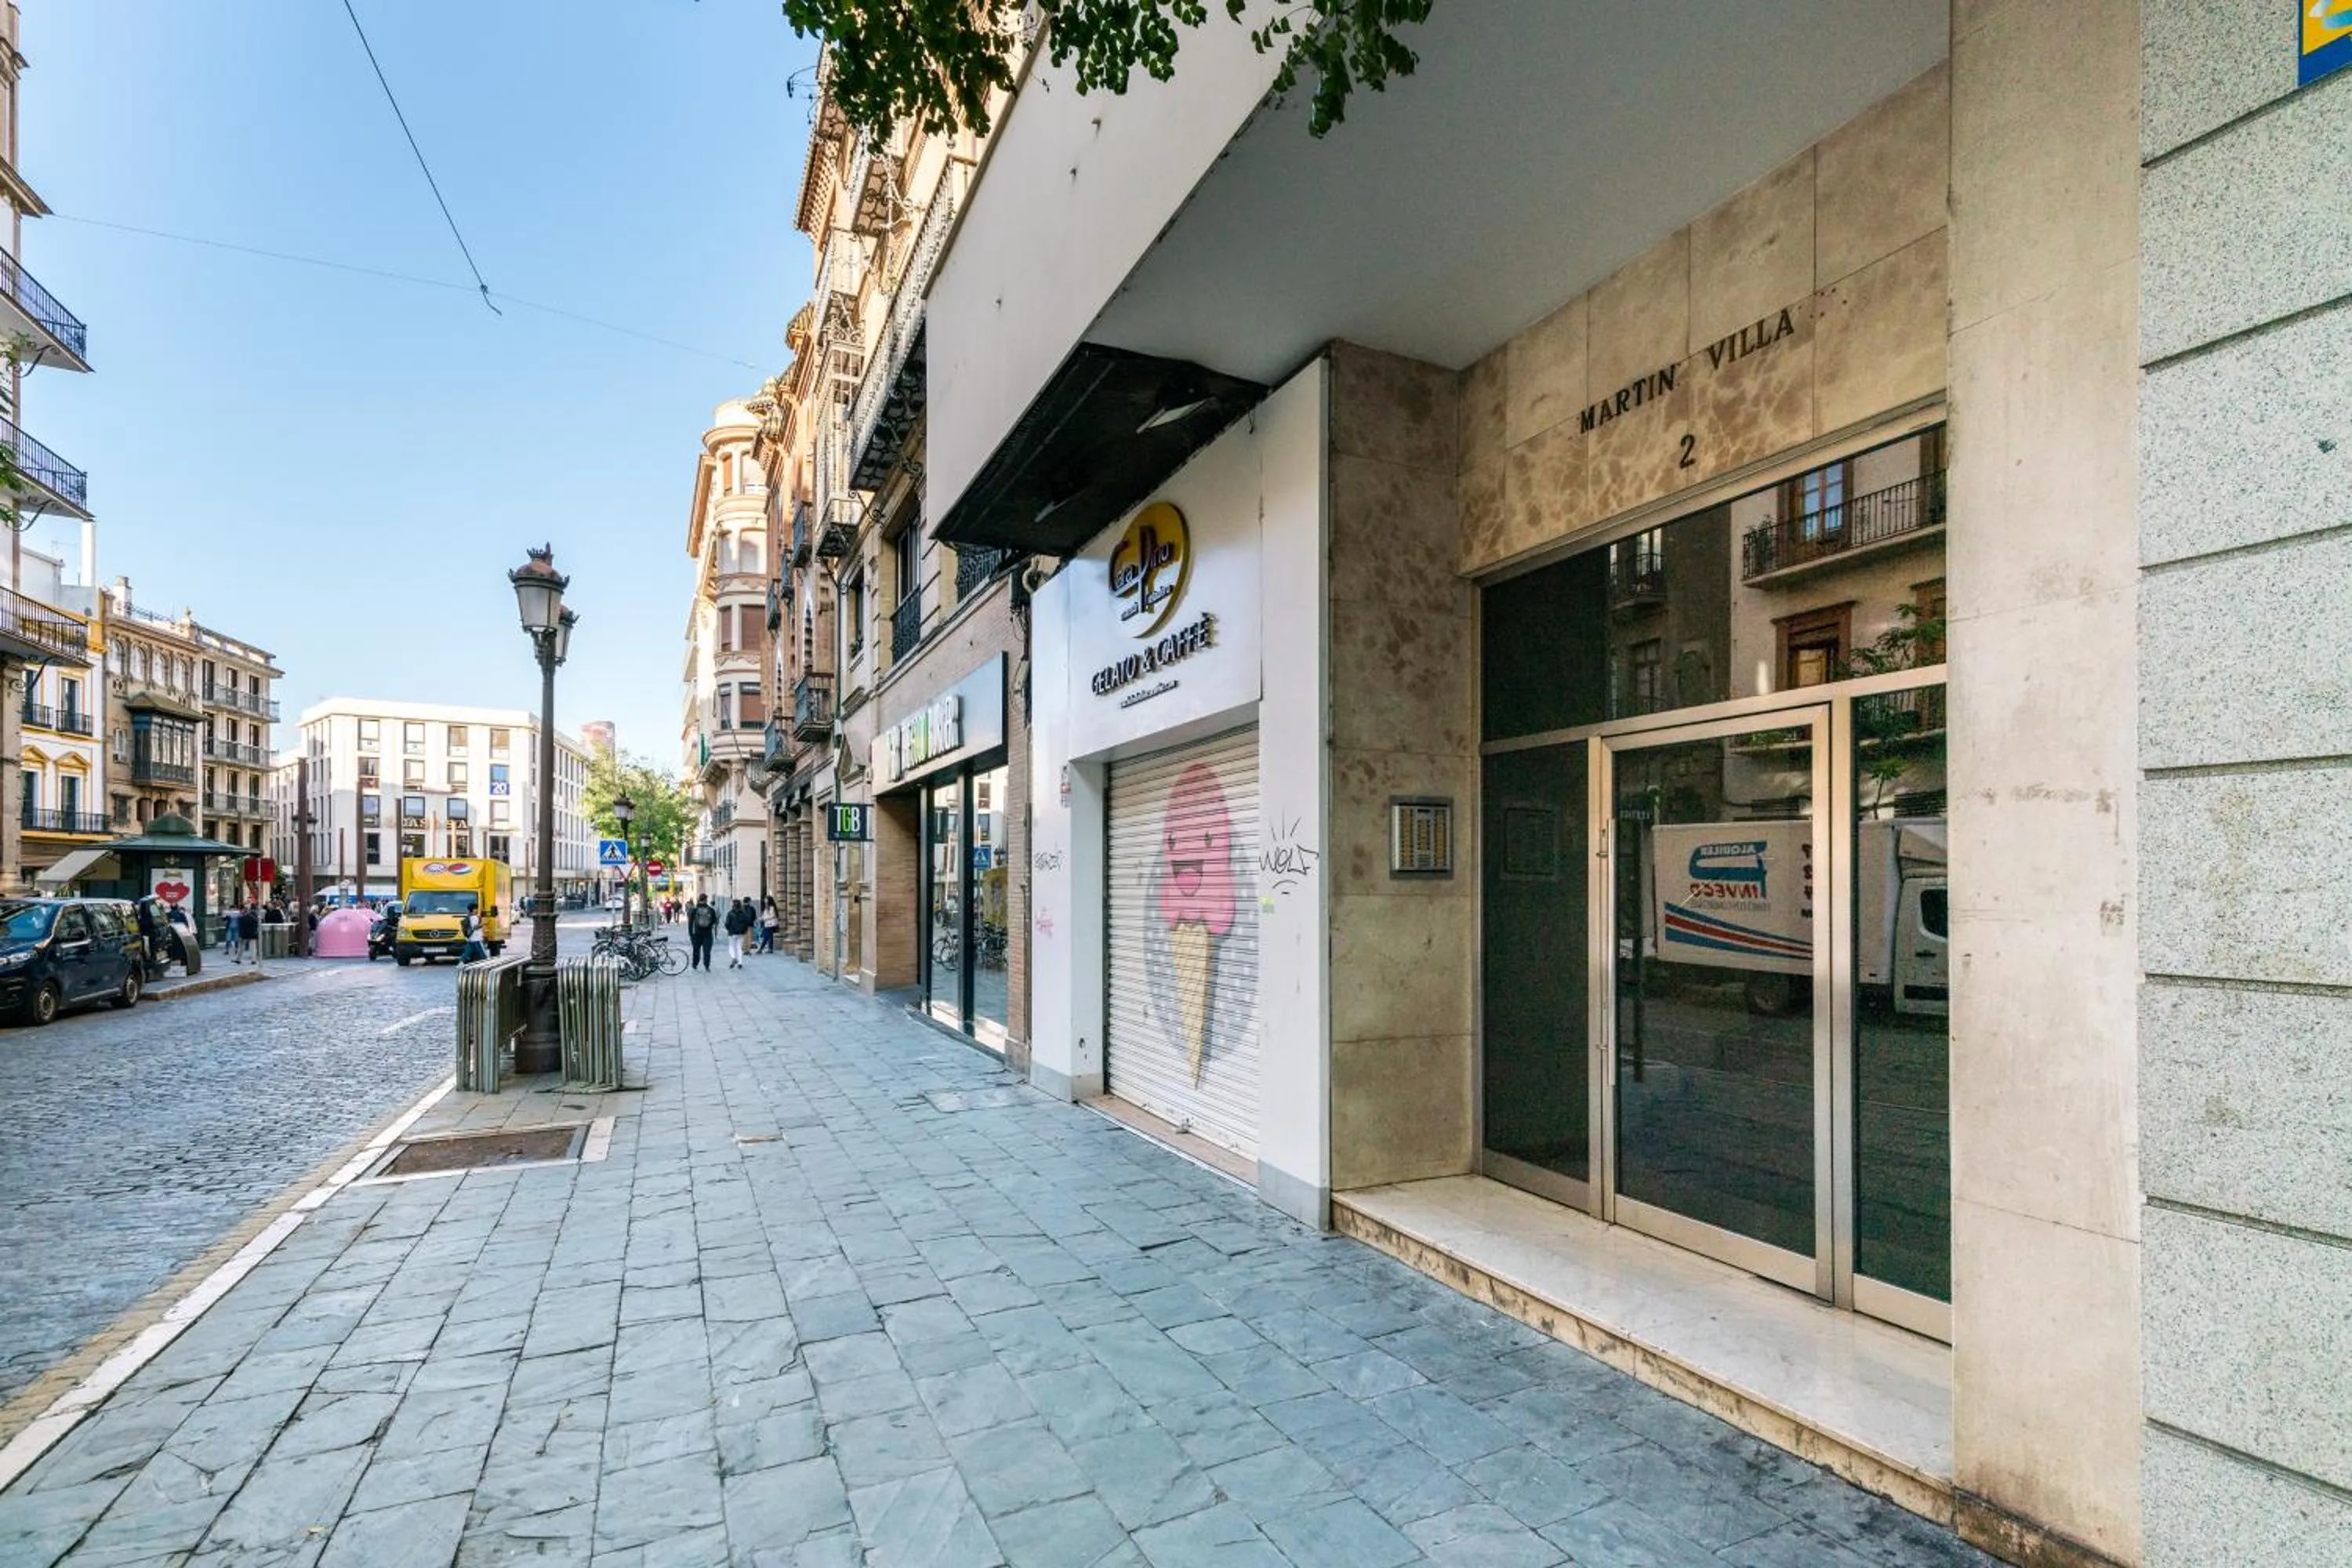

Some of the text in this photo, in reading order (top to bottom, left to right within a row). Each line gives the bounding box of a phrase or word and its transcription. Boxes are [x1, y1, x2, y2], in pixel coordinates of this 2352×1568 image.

[1580, 307, 1795, 434] MARTIN VILLA
[1679, 434, 1696, 469] 2
[1091, 654, 1141, 696] GELATO
[1142, 647, 1156, 673] &
[834, 806, 861, 833] TGB
